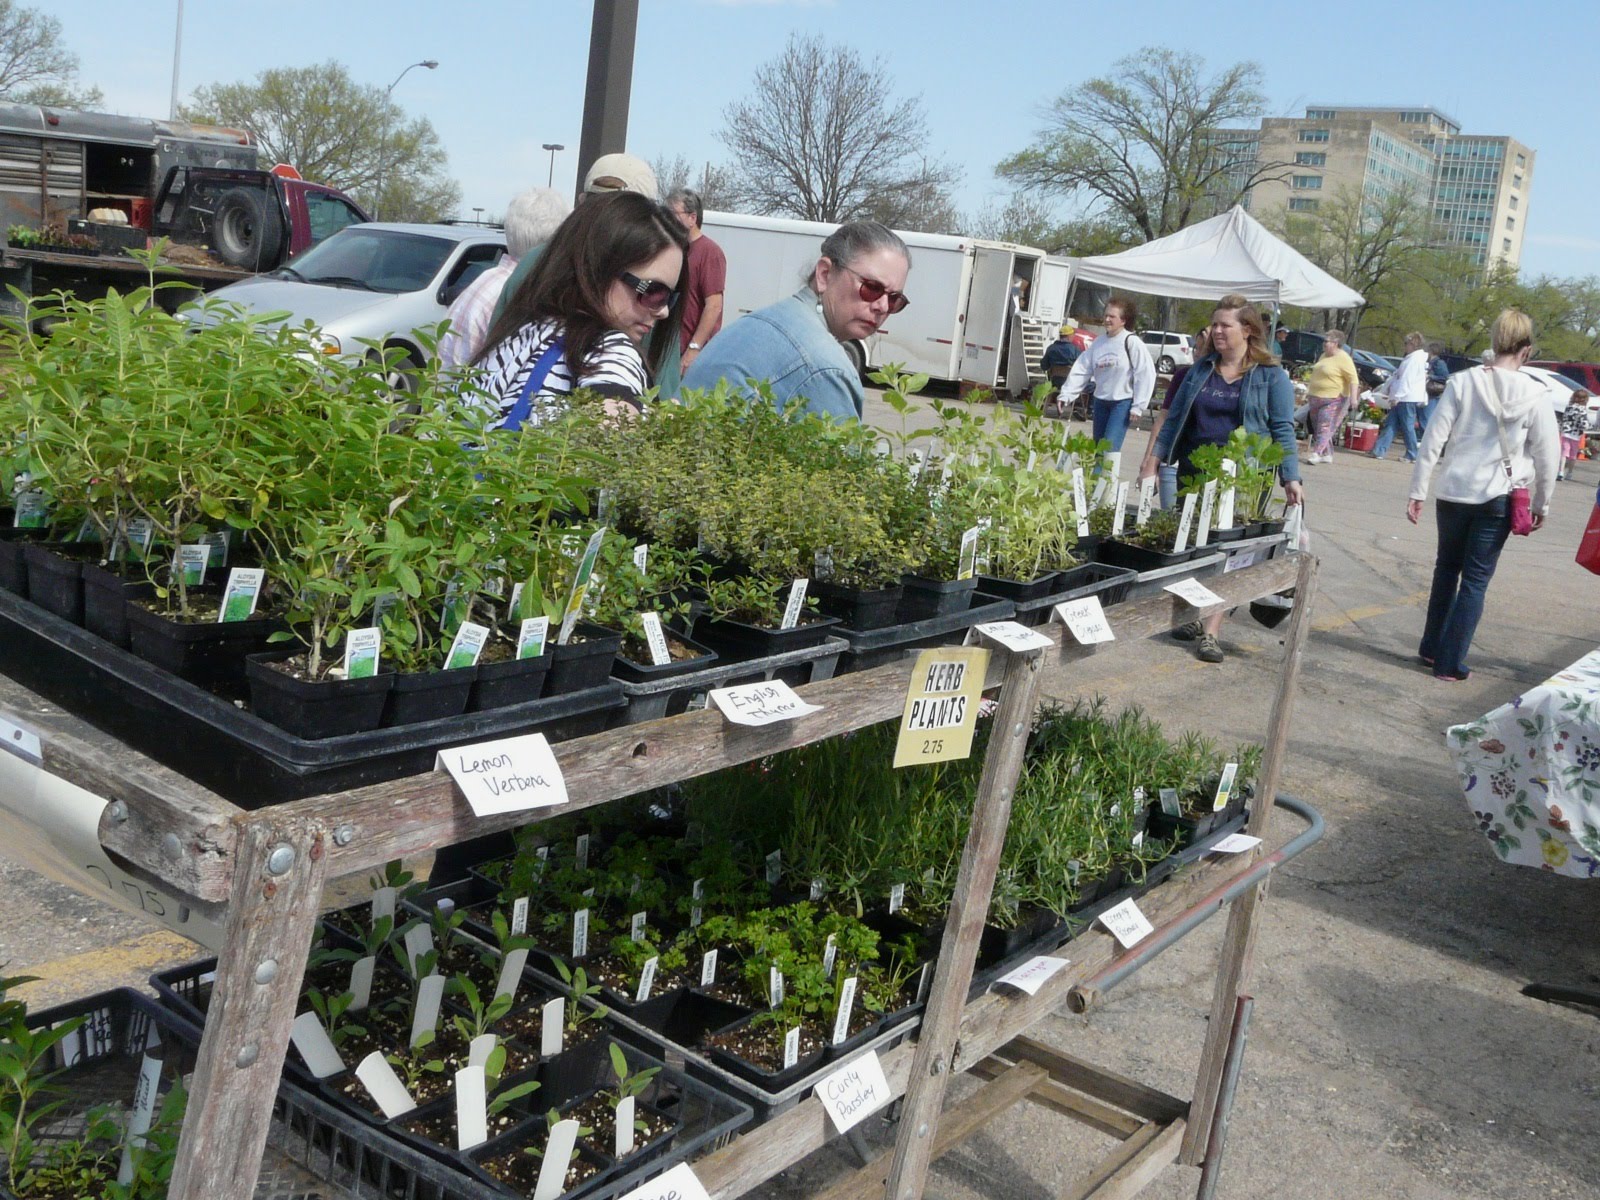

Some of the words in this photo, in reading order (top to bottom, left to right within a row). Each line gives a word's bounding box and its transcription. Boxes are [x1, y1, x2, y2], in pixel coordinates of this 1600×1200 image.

[924, 663, 965, 692] HERB
[727, 686, 780, 709] English
[908, 696, 967, 729] PLANTS
[922, 739, 944, 754] 2.75
[460, 754, 513, 774] Lemon
[483, 773, 551, 796] Verbena
[843, 985, 853, 1013] PARSLEY
[827, 1071, 862, 1100] Curly
[836, 1084, 877, 1121] Parsley
